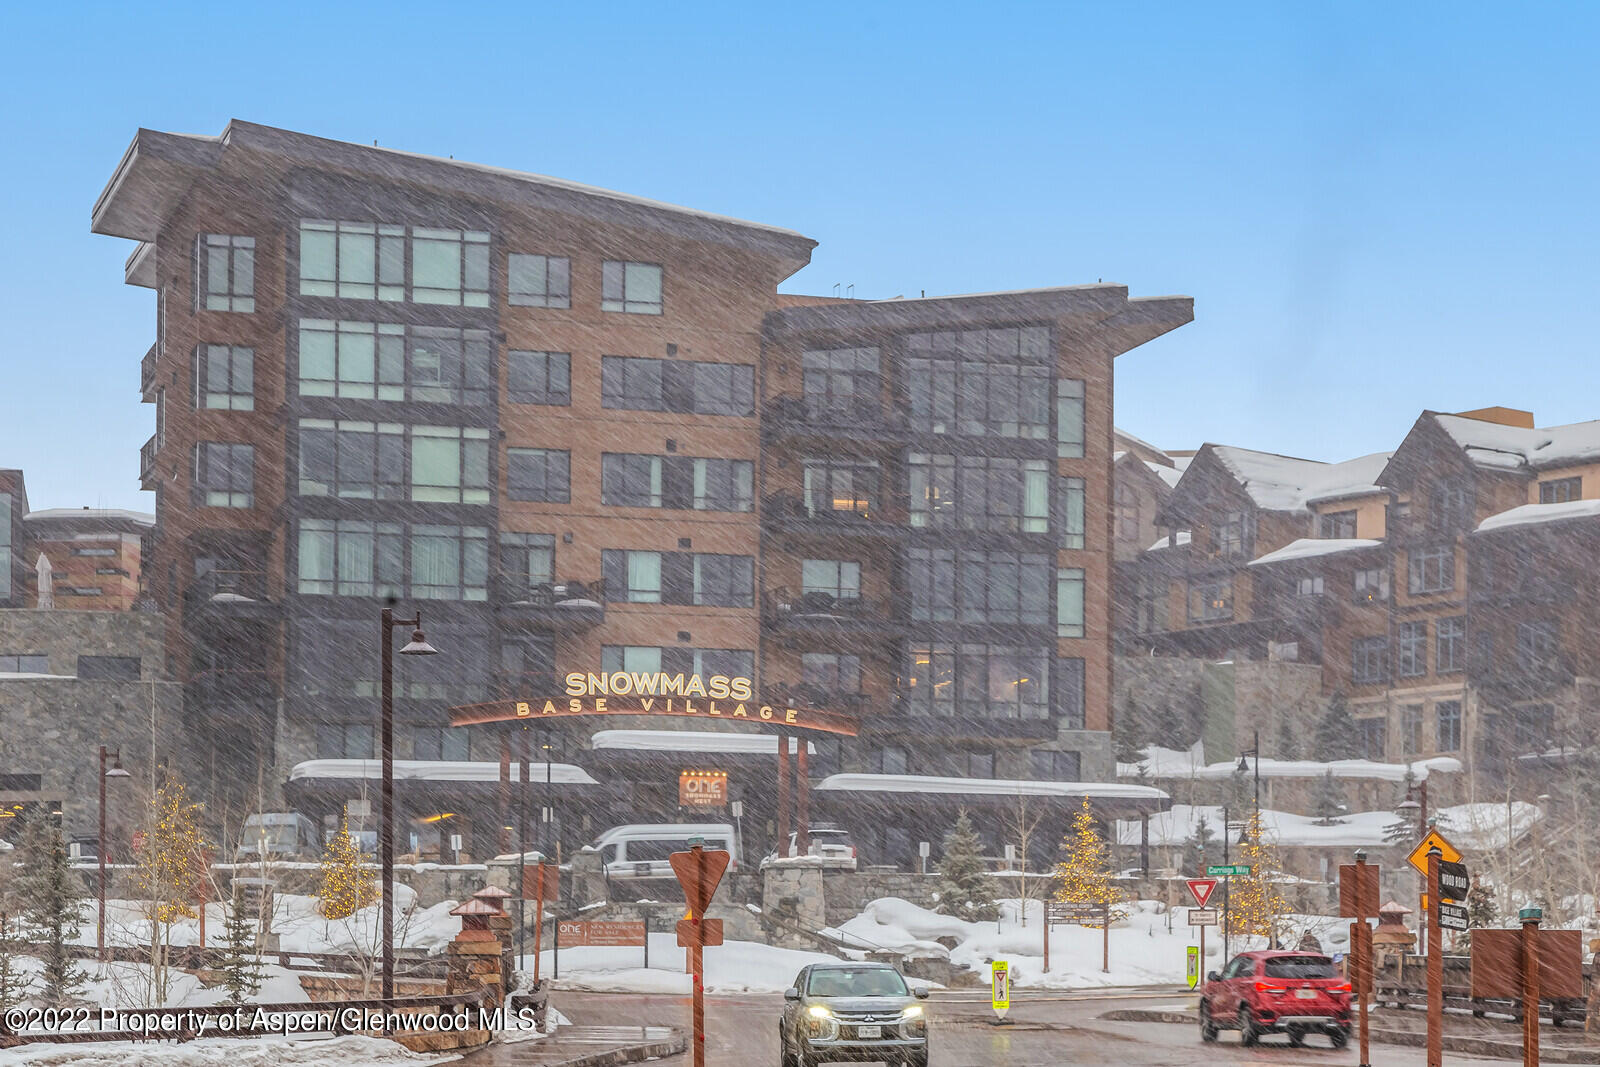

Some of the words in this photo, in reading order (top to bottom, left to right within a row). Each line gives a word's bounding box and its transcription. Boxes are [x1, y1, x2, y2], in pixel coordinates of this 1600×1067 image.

[565, 671, 752, 700] SNOWMASS
[516, 698, 608, 716] BASE
[641, 698, 798, 723] VILLAGE
[1235, 867, 1250, 875] Way
[1442, 873, 1455, 887] WOOD
[1455, 876, 1467, 888] ROAD
